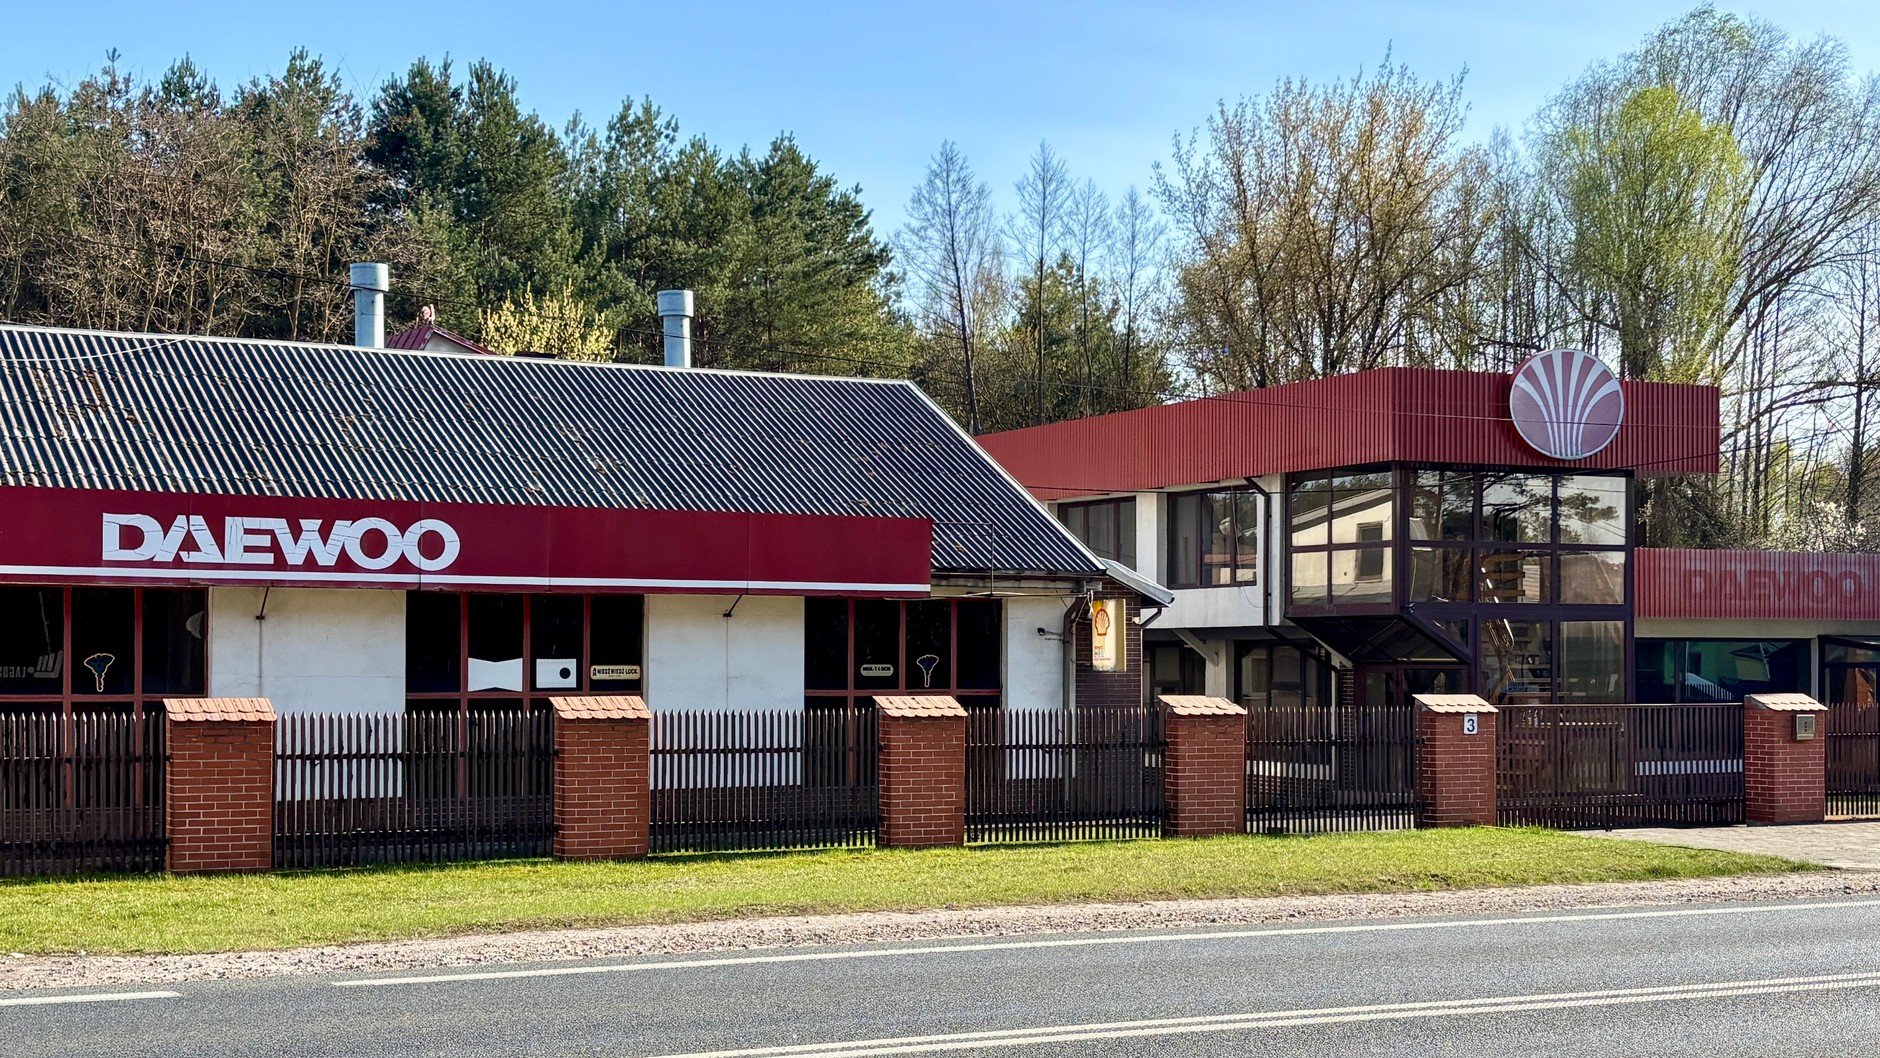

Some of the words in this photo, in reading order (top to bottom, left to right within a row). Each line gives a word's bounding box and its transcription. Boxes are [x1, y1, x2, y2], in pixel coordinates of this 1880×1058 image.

[102, 512, 461, 571] DAEWOO
[1684, 569, 1864, 605] DAEWOO
[1466, 718, 1475, 732] 3
